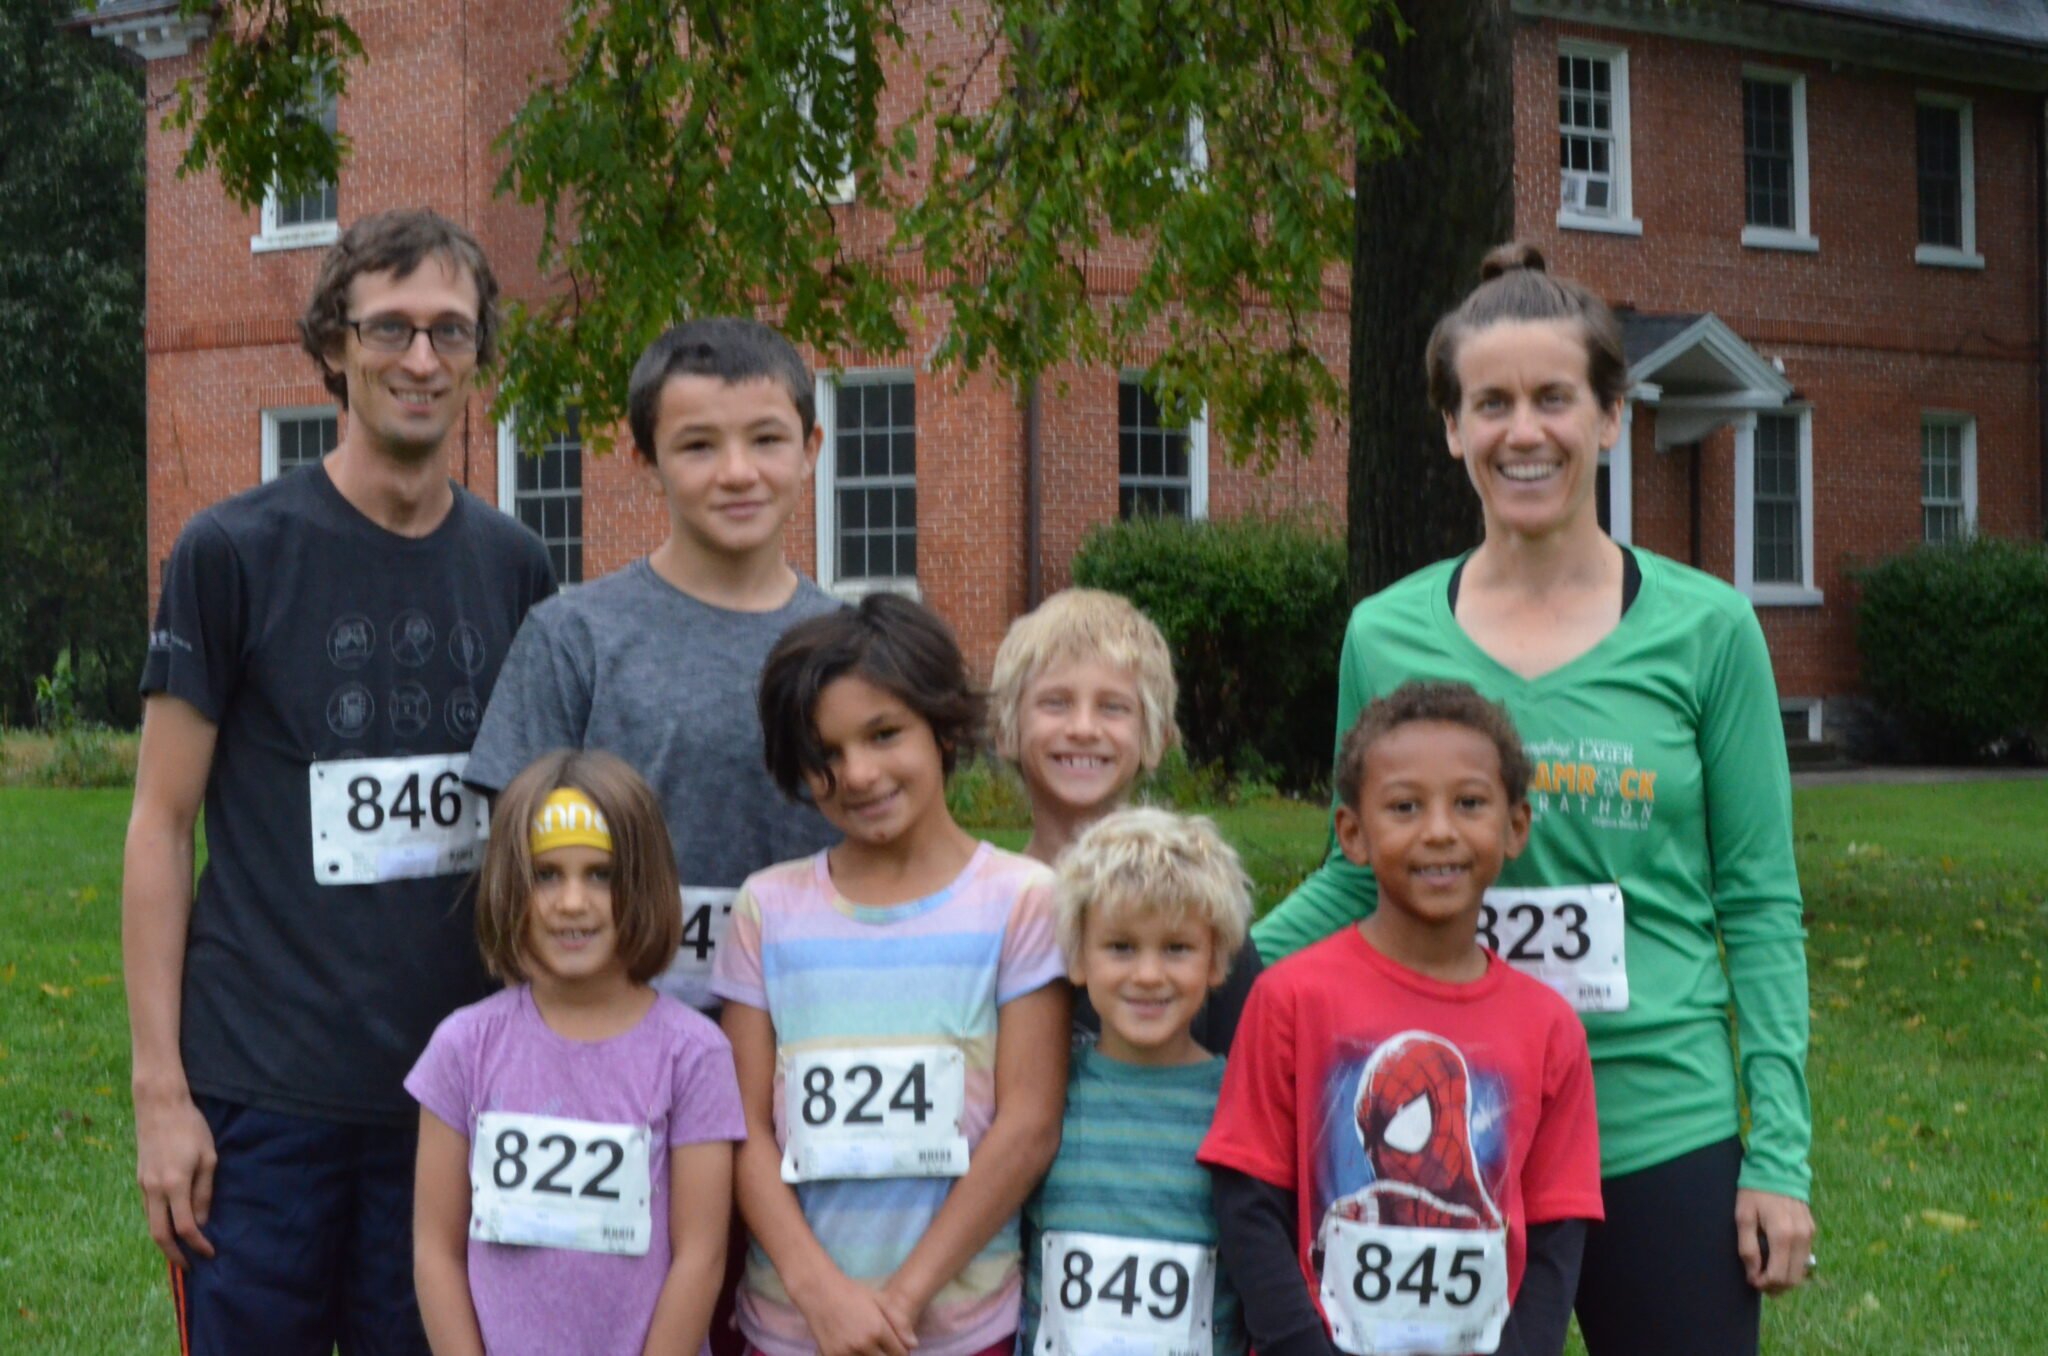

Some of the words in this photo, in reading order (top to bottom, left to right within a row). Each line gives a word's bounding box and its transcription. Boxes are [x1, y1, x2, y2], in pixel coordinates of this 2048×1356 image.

[347, 771, 462, 832] 846
[802, 1062, 934, 1126] 824
[493, 1129, 624, 1200] 822
[1060, 1250, 1190, 1320] 849
[1353, 1242, 1484, 1305] 845
